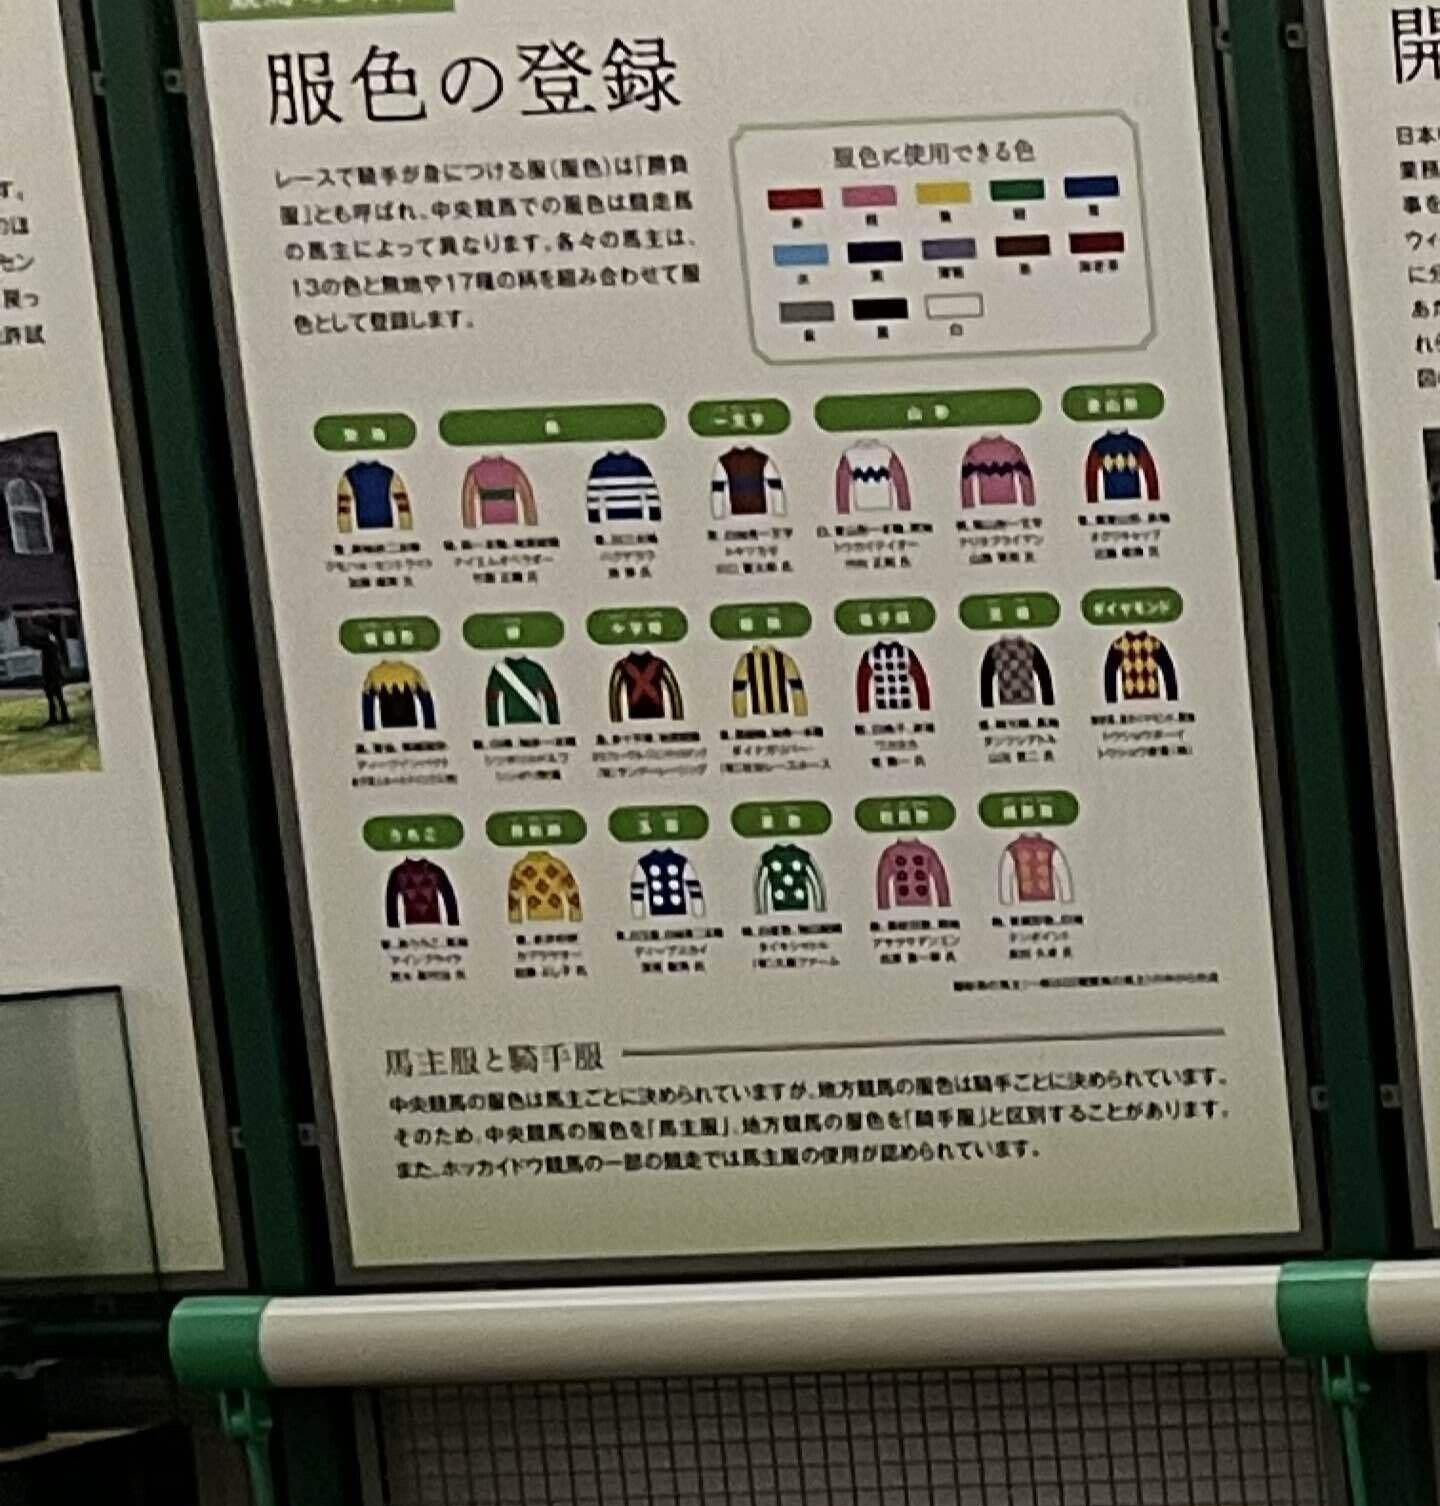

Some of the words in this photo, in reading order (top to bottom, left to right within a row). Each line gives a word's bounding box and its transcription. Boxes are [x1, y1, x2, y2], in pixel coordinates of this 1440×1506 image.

[268, 37, 680, 126] 服色の登録
[386, 1042, 604, 1078] 馬主服と騎手服
